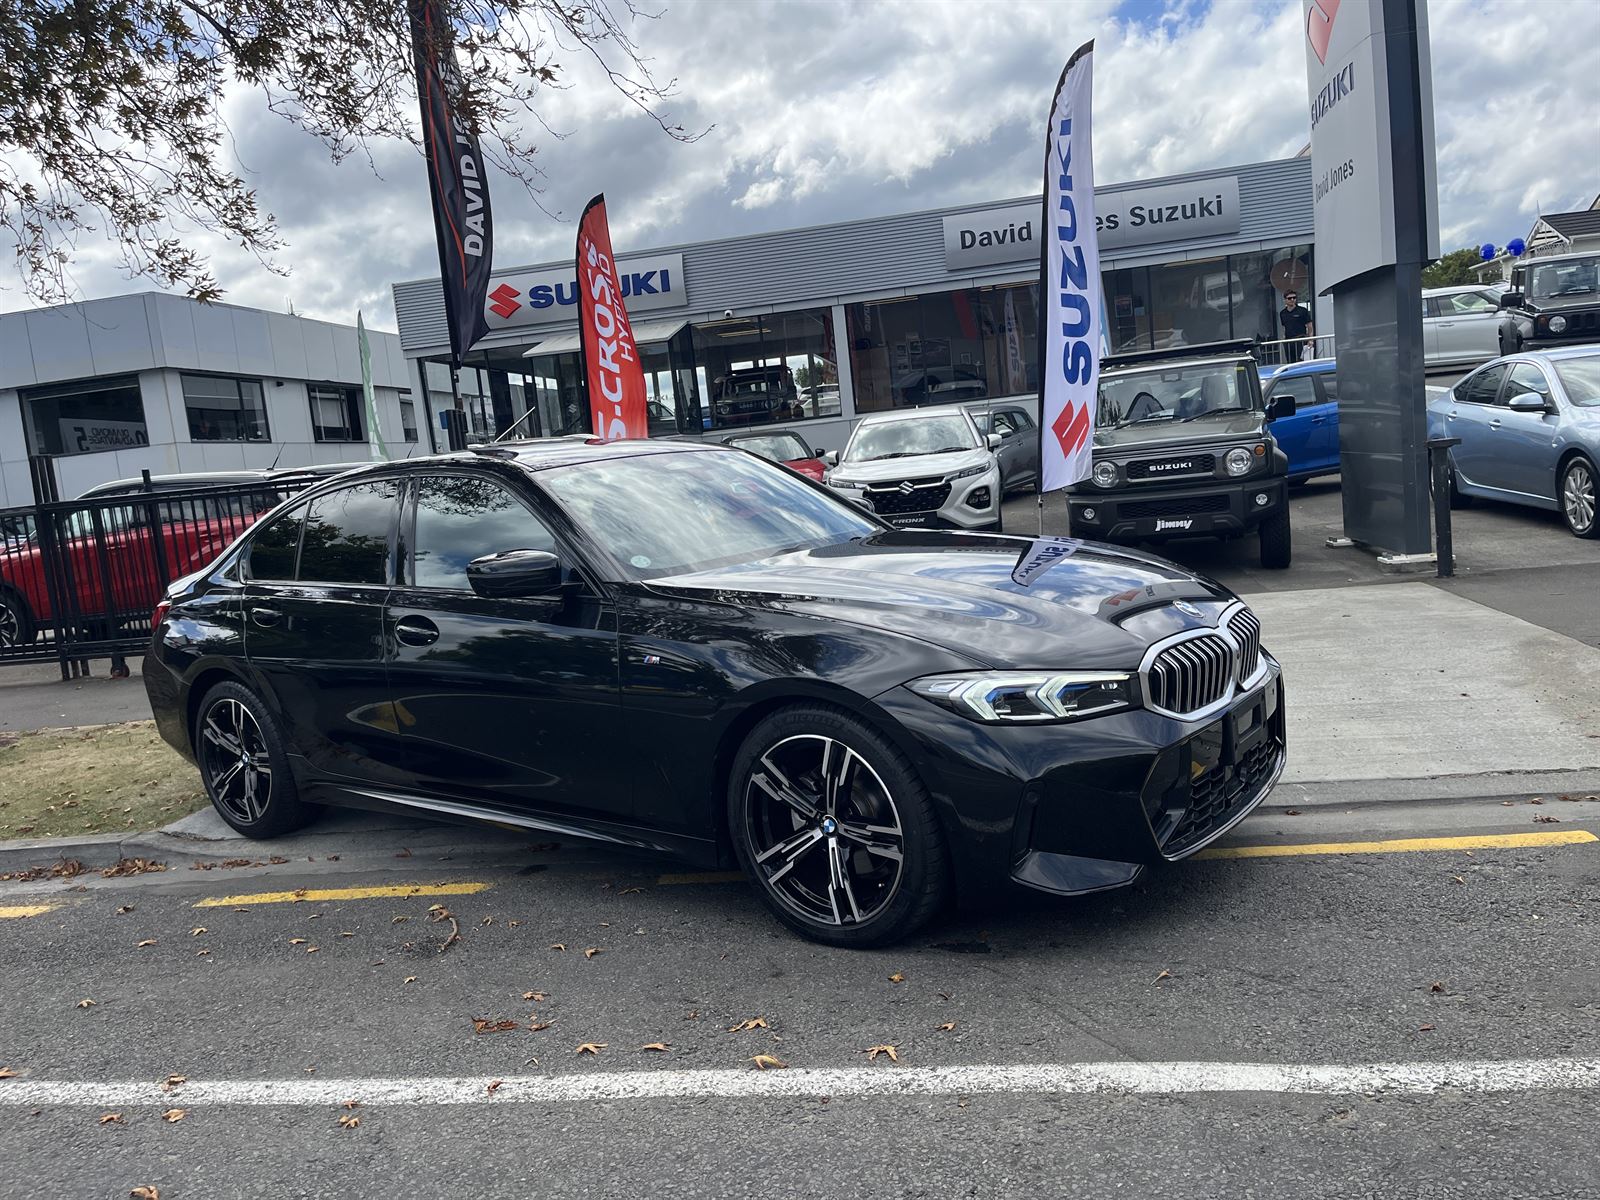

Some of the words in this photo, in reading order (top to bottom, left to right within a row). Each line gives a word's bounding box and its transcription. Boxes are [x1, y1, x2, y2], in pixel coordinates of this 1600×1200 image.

[1311, 61, 1355, 130] SUZUKI
[1330, 158, 1354, 191] Jones
[460, 154, 485, 257] DAVID
[960, 221, 1033, 250] David
[1129, 194, 1223, 228] Suzuki
[1057, 118, 1092, 387] SUZUKI
[1149, 462, 1192, 472] SUZUKI
[892, 517, 926, 525] FRONX
